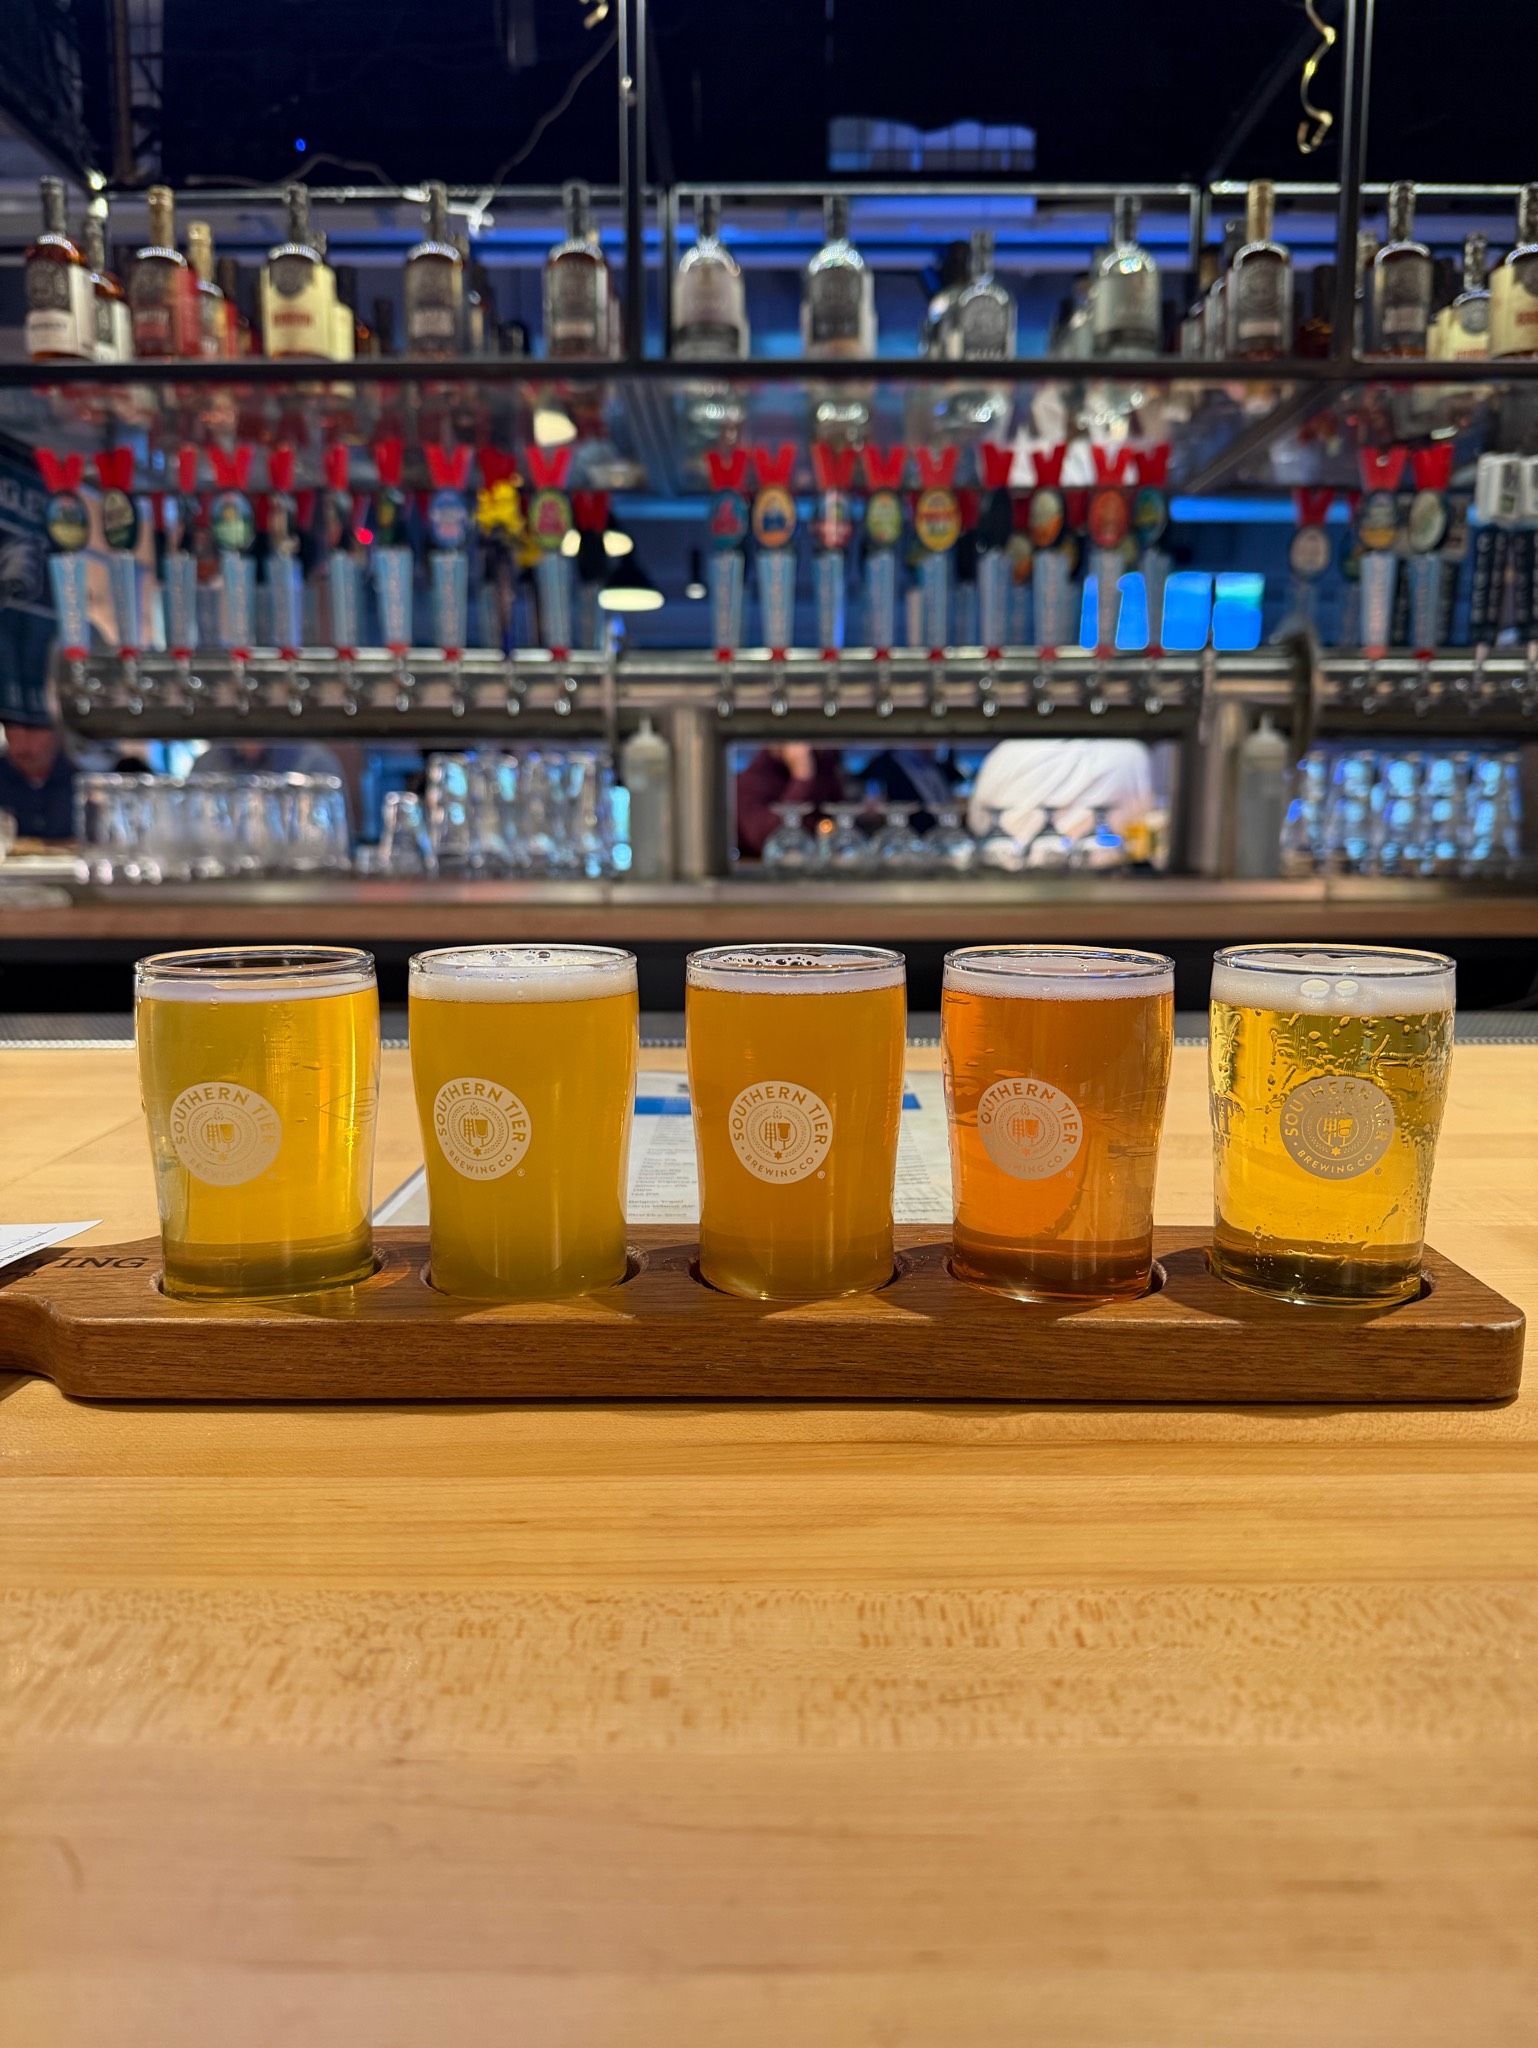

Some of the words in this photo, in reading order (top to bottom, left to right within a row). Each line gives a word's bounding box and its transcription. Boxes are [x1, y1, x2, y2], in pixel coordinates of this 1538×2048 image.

[173, 1086, 250, 1145] SOUTHERN
[252, 1103, 277, 1145] TIER
[436, 1081, 503, 1137] SOUTHERN
[504, 1100, 527, 1143] TIER
[732, 1085, 808, 1141] SOUTHERN
[808, 1103, 829, 1145] TIER
[1056, 1102, 1079, 1145] TIER
[1284, 1081, 1373, 1137] SOUTHERN
[448, 1150, 497, 1175] BREWING
[498, 1154, 513, 1168] CO
[745, 1154, 798, 1178] BREWING
[799, 1156, 814, 1171] CO
[1047, 1155, 1063, 1168] CO
[1296, 1149, 1355, 1174] BREWING
[1357, 1153, 1373, 1167] CO
[30, 1256, 150, 1269] ING
